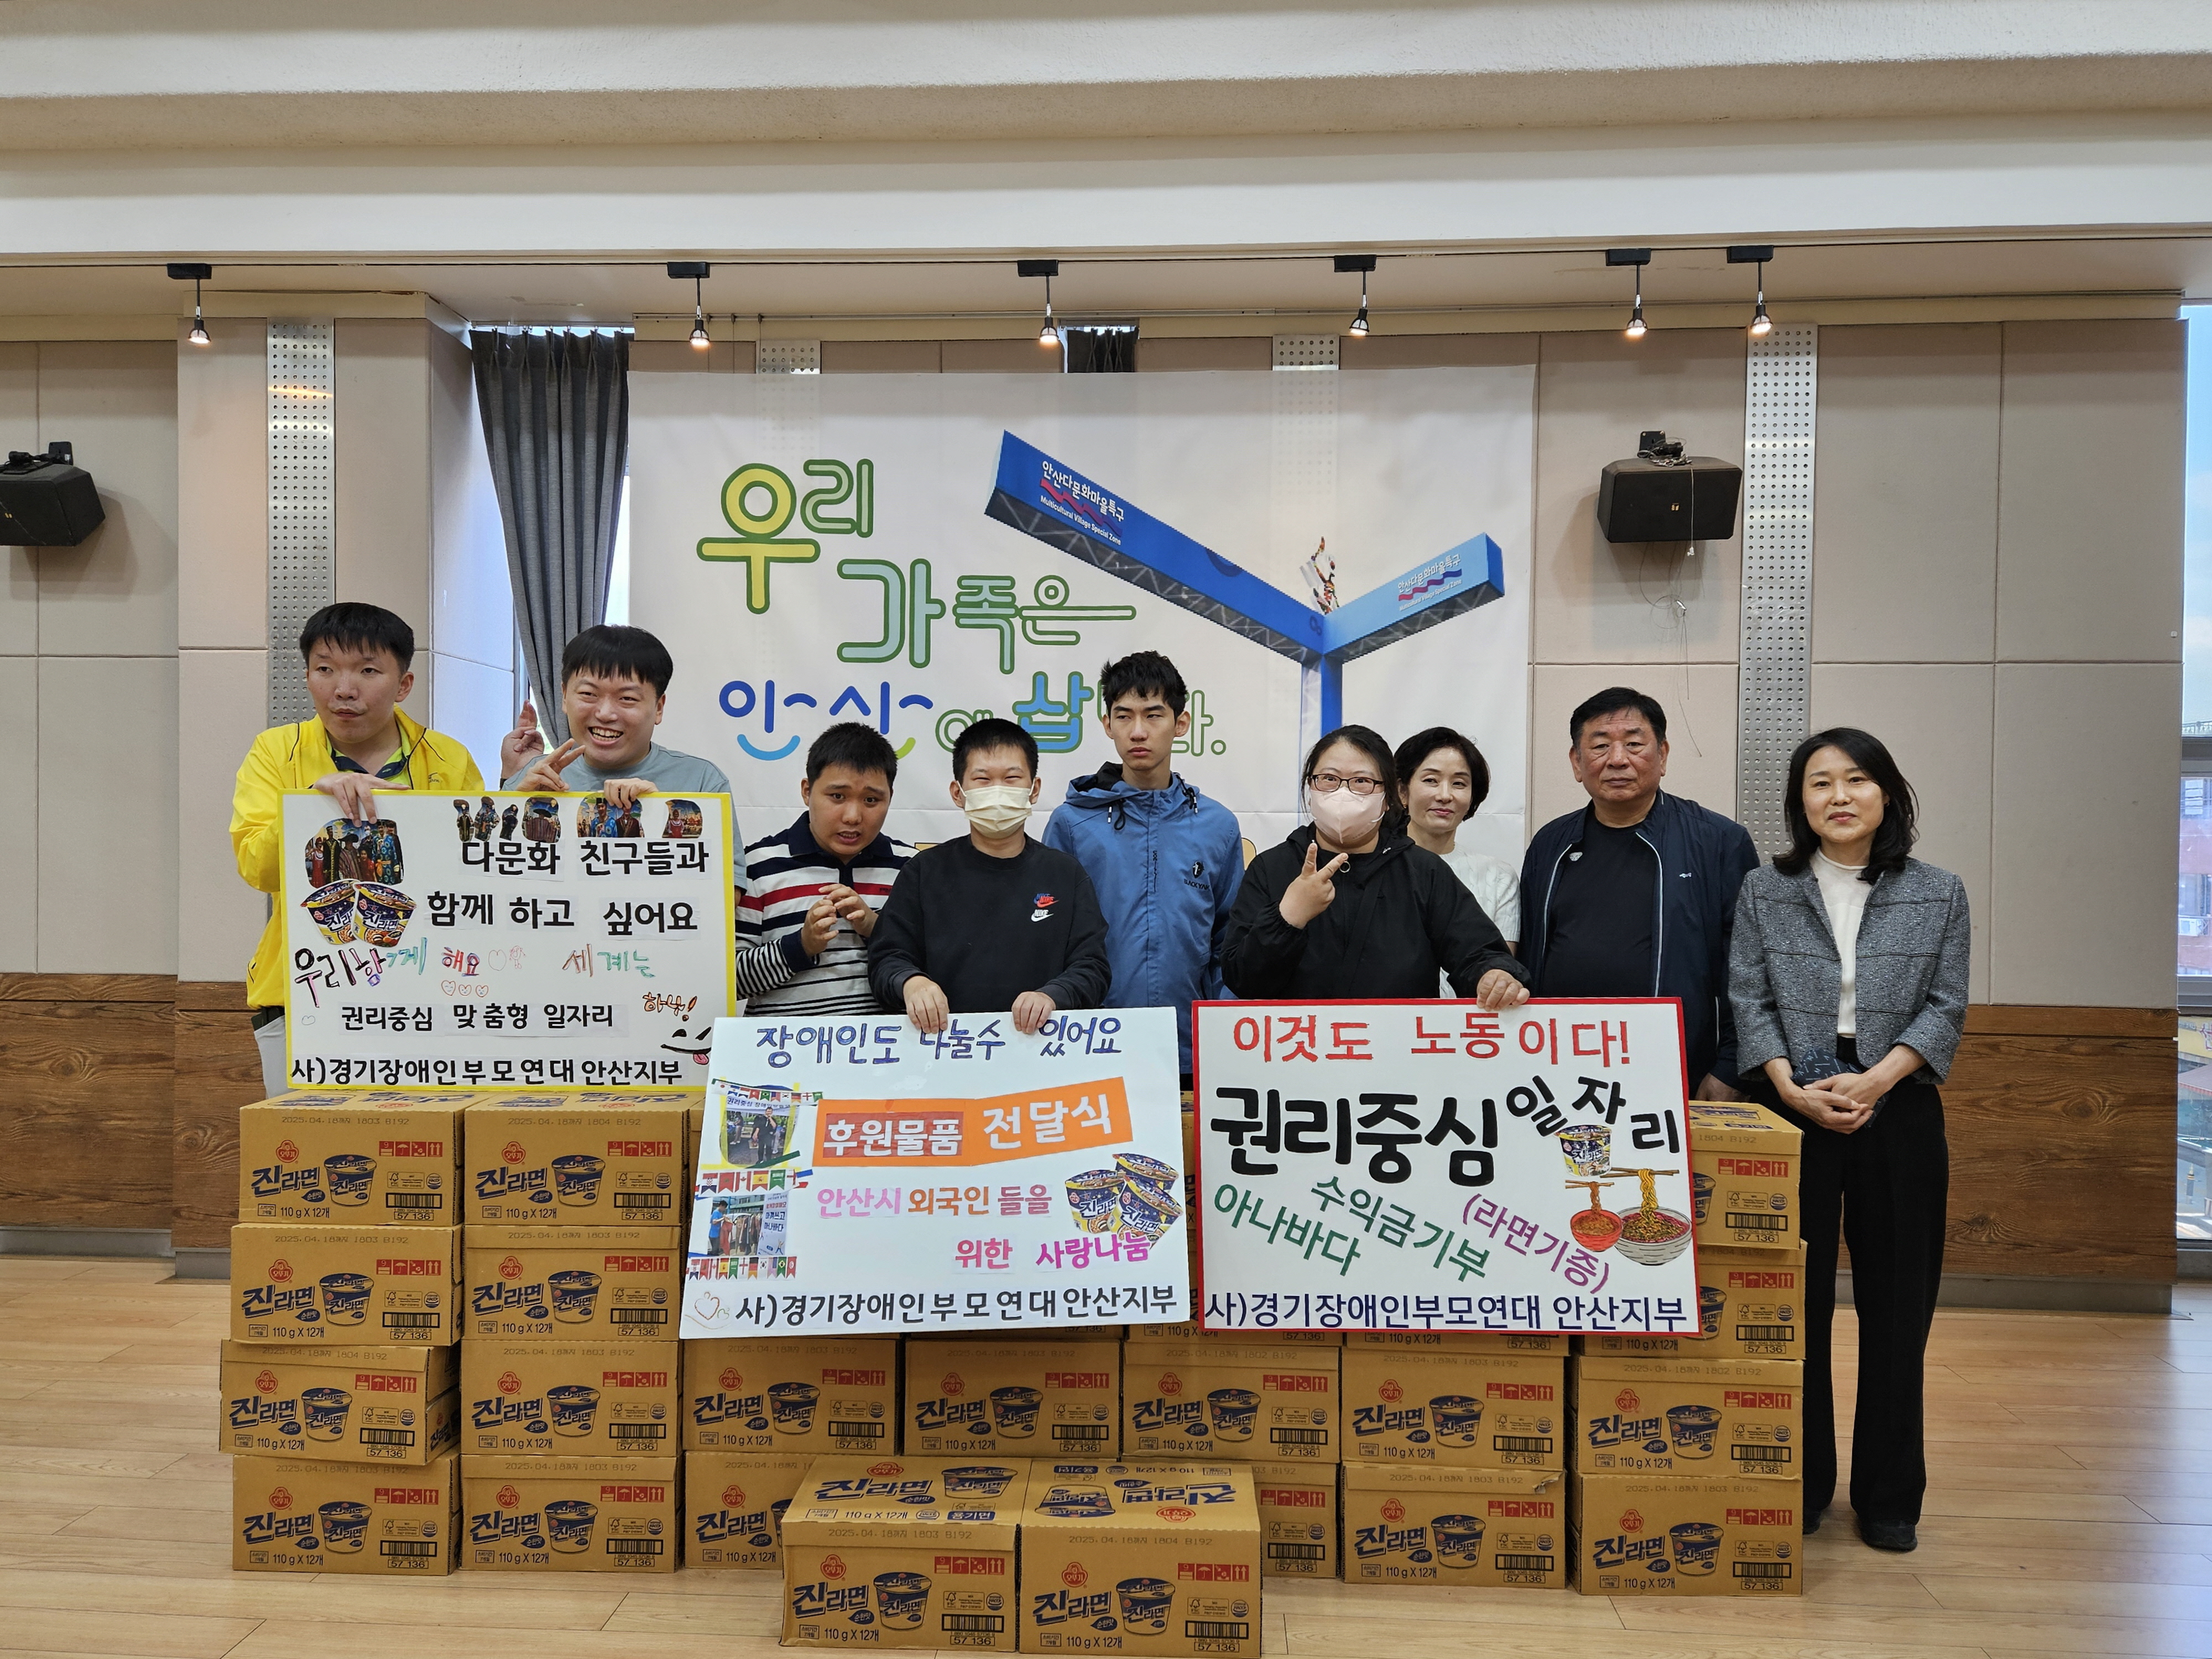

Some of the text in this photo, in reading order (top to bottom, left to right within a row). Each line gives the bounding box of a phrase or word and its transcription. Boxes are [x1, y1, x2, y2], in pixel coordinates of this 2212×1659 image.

[1042, 461, 1124, 522] 안산다문화마을특구
[696, 458, 874, 615] 우리
[1040, 495, 1121, 545] Multicultural Village Special Zone
[836, 558, 1136, 675] 가족은
[462, 839, 709, 876] 다문화 친구들과
[427, 890, 697, 935] 함께 하고 싶어요
[341, 1005, 432, 1031] 권리중심
[544, 1004, 612, 1029] 일자리
[757, 1024, 901, 1067] 장애인도
[1039, 1015, 1121, 1057] 있어요
[1233, 1015, 1373, 1063] 이것도
[823, 1094, 1113, 1156] 후원물품 전달식
[1211, 1075, 1680, 1187] 권리중심 일자리
[252, 1165, 320, 1197] 진라면
[475, 1166, 547, 1199] 진라면
[817, 1187, 901, 1217] 안산시
[1214, 1184, 1361, 1277] 아나바다
[956, 1233, 1151, 1271] 위한 사랑나눔
[242, 1285, 315, 1318] 진라면
[472, 1282, 544, 1316] 진라면
[1204, 1293, 1687, 1333] 사)경기장애인부모연대 안산지부
[229, 1396, 298, 1429] 진라면
[472, 1397, 543, 1429] 진라면
[693, 1393, 764, 1426] 진라면
[915, 1398, 986, 1431] 진라면
[1132, 1398, 1203, 1432] 진라면
[1352, 1404, 1425, 1436] 진라면
[1162, 1441, 1213, 1451] 110 g X 12개
[1588, 1415, 1662, 1448] 진라면
[815, 1479, 932, 1502] 진라면
[243, 1511, 314, 1545] 진라면
[471, 1510, 540, 1545] 진라면
[696, 1510, 767, 1543] 진라면
[1354, 1525, 1426, 1558] 진라면
[726, 1552, 776, 1563] 110 g X 12개
[1593, 1535, 1665, 1568] 진라면
[792, 1583, 869, 1619] 진라면
[855, 1613, 871, 1621] 순한맛
[1033, 1590, 1112, 1625] 진라면
[825, 1629, 879, 1641] 110 g X 12개
[1097, 1620, 1114, 1629] 순한맛
[1067, 1637, 1122, 1648] 110 g X 12개
